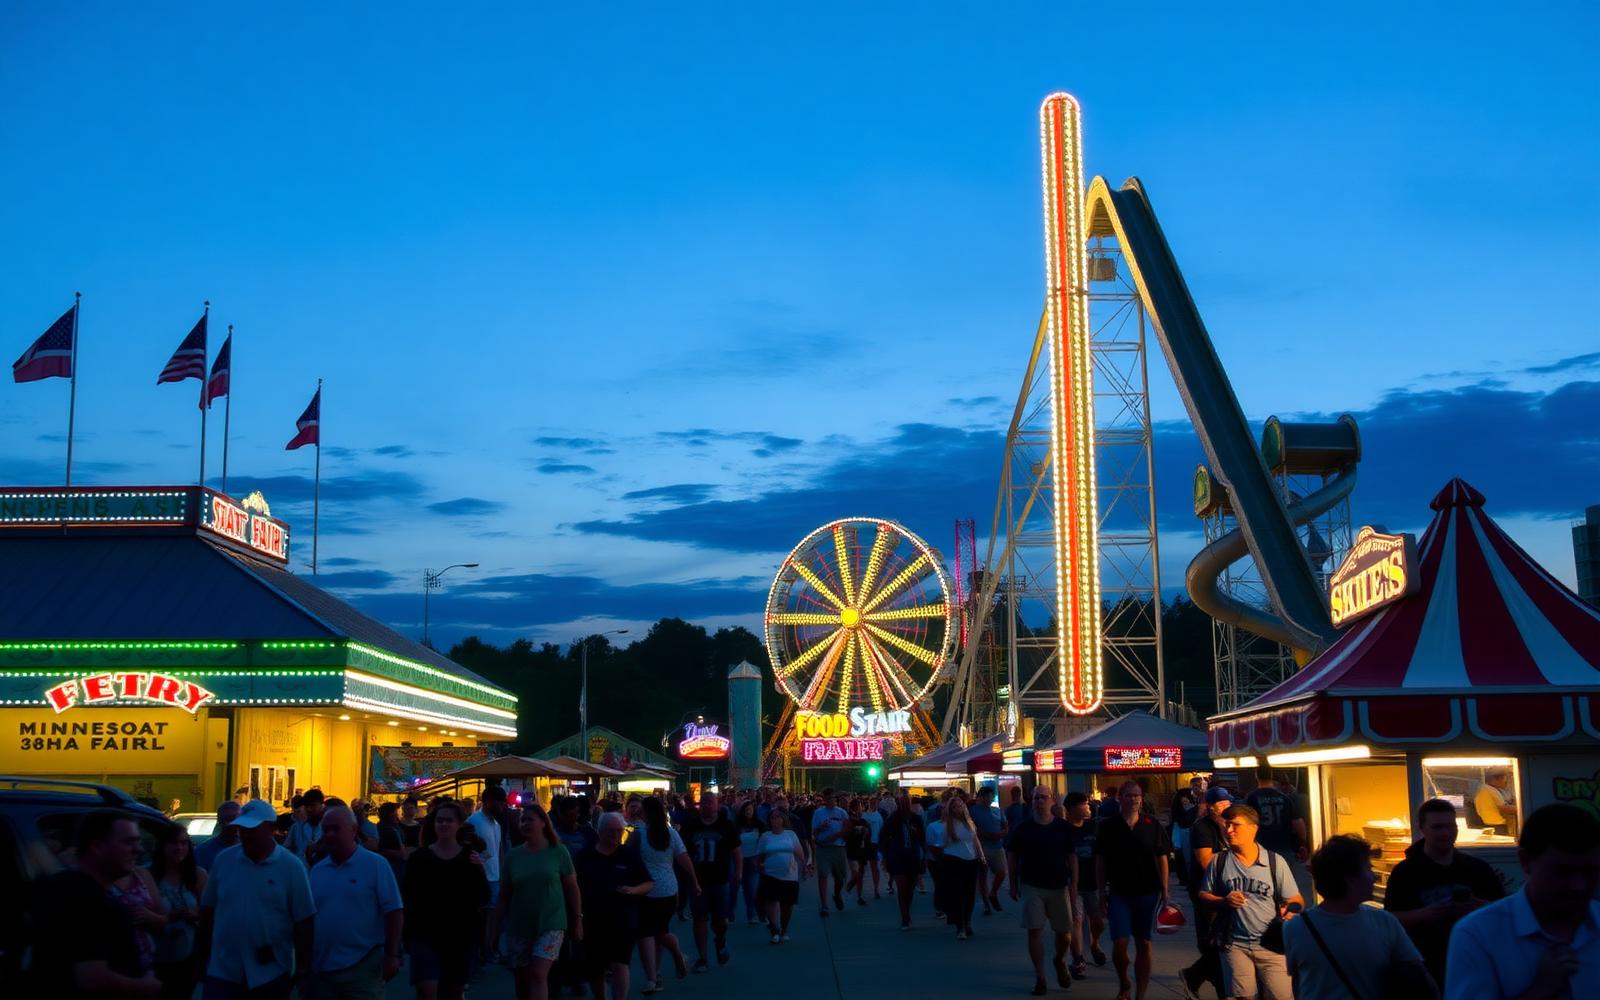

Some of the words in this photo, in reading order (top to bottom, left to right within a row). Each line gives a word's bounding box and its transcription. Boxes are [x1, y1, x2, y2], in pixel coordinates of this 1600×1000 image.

[45, 671, 215, 714] FETRY
[19, 721, 169, 736] MINNESOAT
[796, 711, 850, 740] FOOD
[20, 737, 80, 751] 38HA
[90, 736, 166, 751] FAIRL
